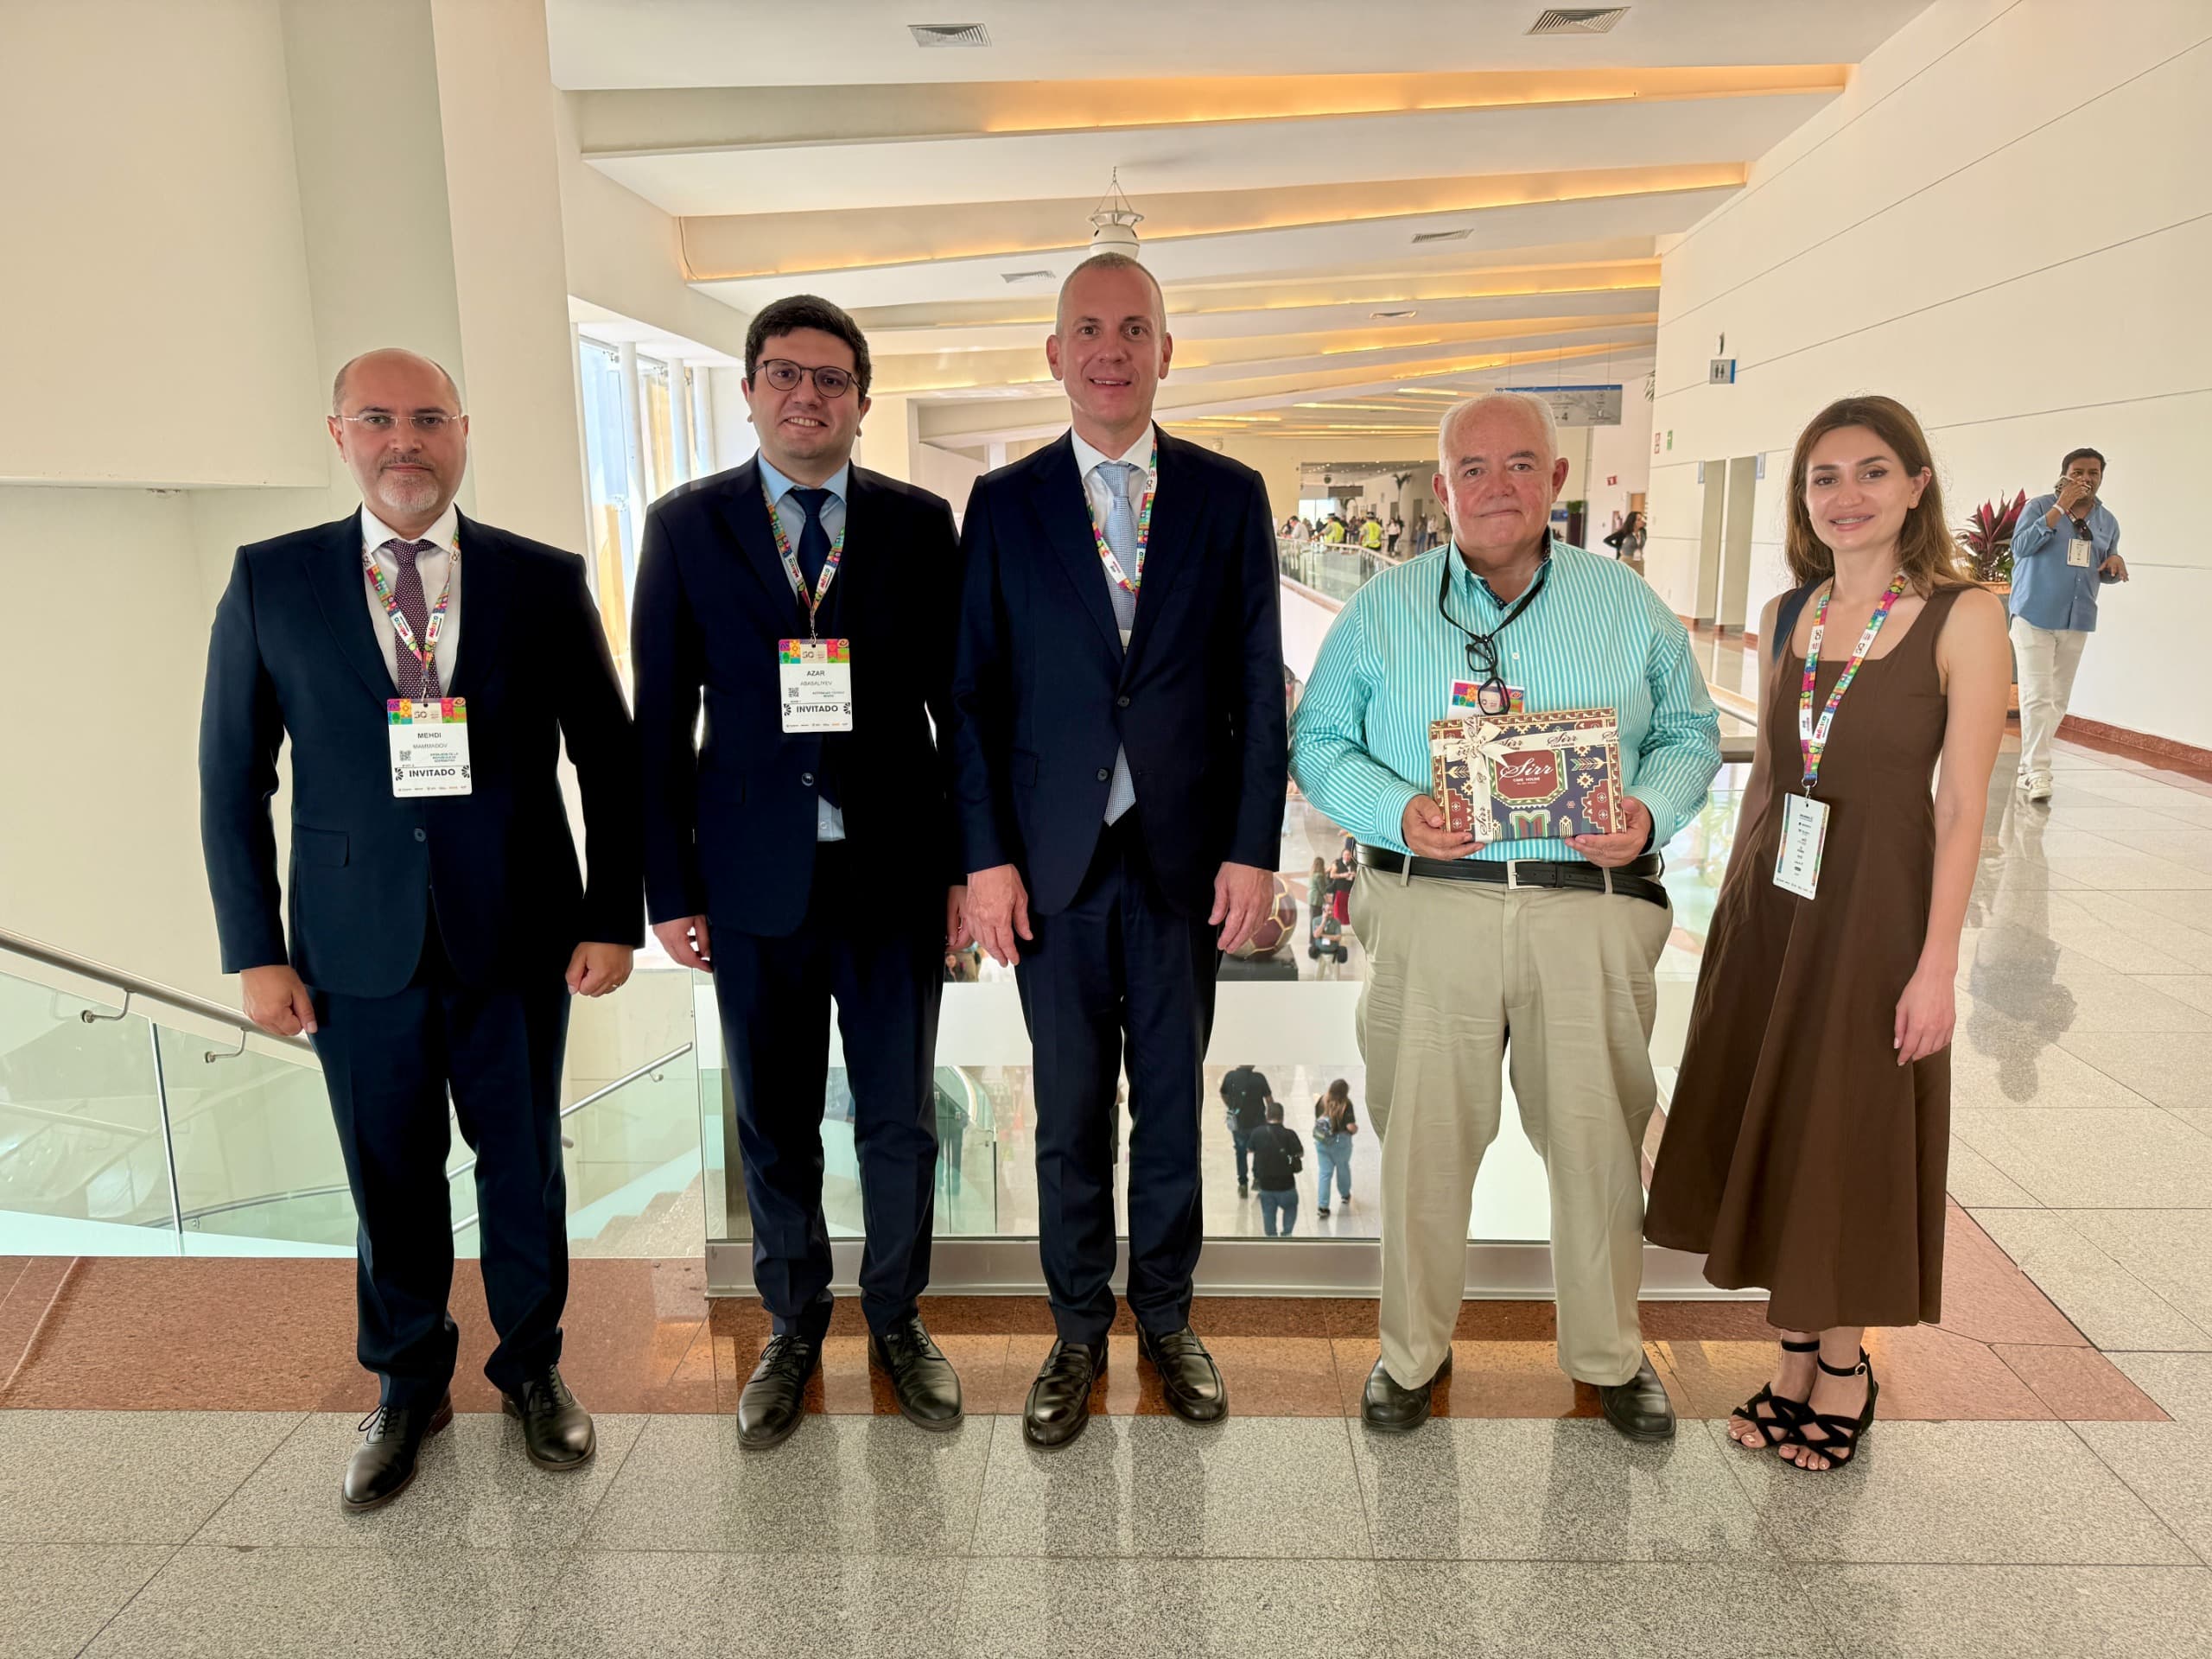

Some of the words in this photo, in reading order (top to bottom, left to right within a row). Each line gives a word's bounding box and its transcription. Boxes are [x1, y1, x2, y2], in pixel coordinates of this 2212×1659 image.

[796, 704, 838, 713] INVITADO
[1547, 731, 1578, 745] Sirr
[409, 768, 456, 778] INVITADO
[1498, 757, 1554, 782] Sirr
